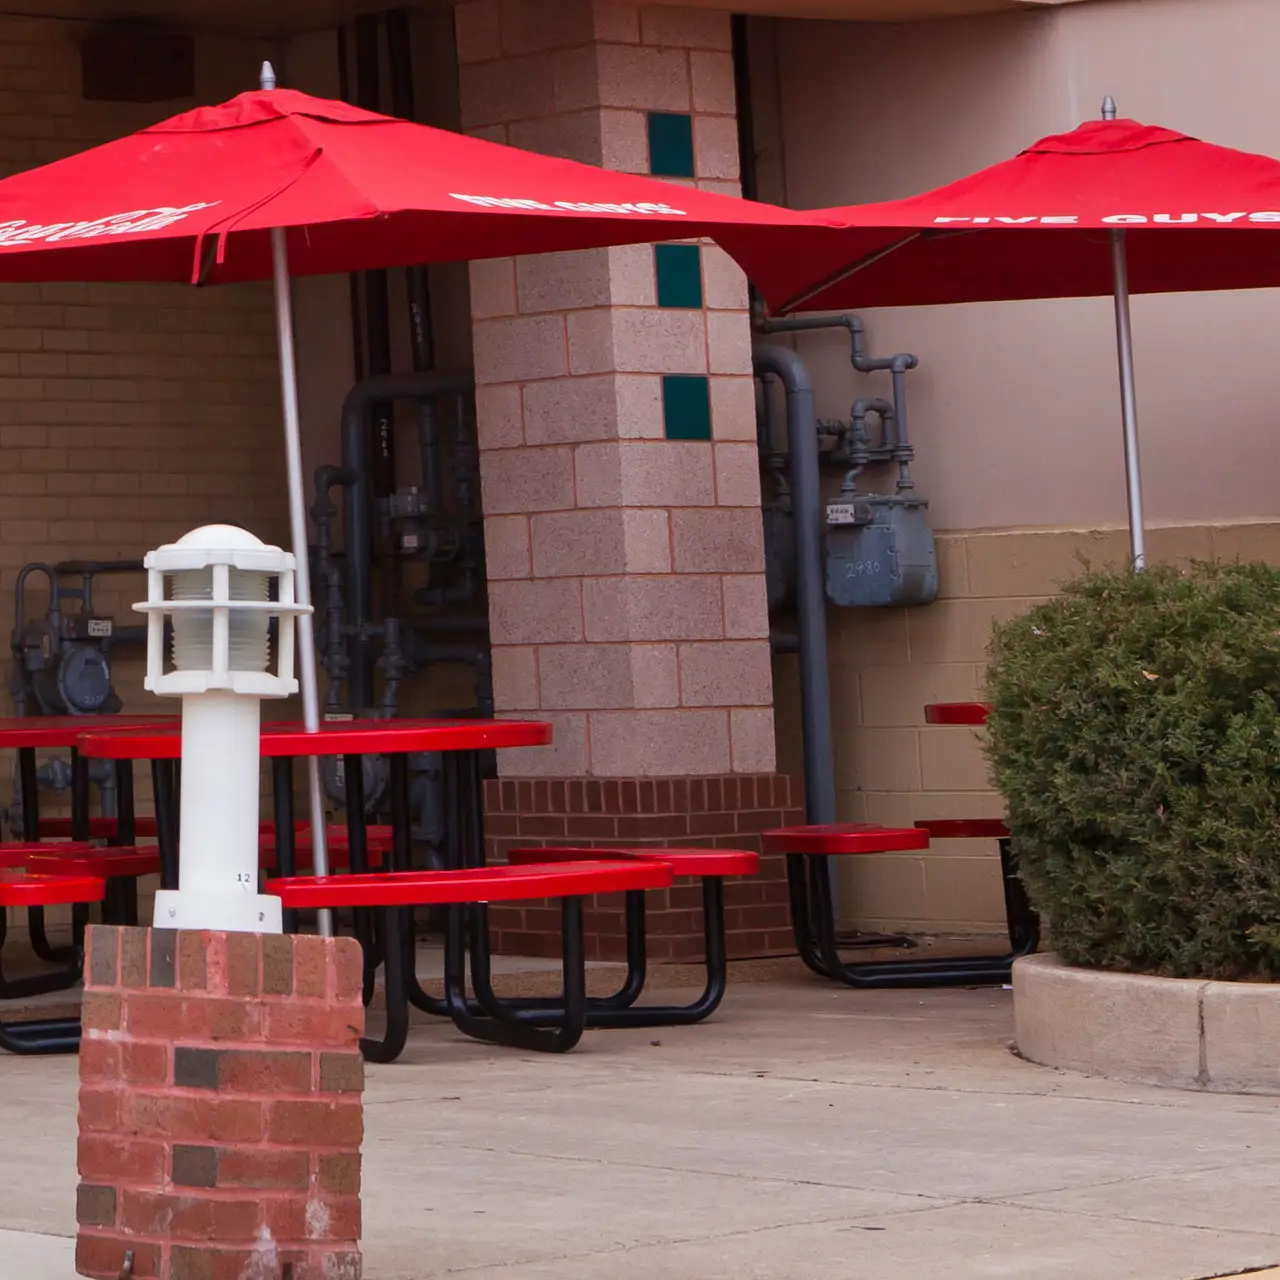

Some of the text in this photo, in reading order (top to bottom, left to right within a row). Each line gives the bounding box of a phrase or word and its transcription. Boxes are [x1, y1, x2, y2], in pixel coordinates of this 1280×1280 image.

[932, 214, 1080, 225] FIVE
[844, 560, 881, 579] 2980
[236, 873, 252, 883] 12
